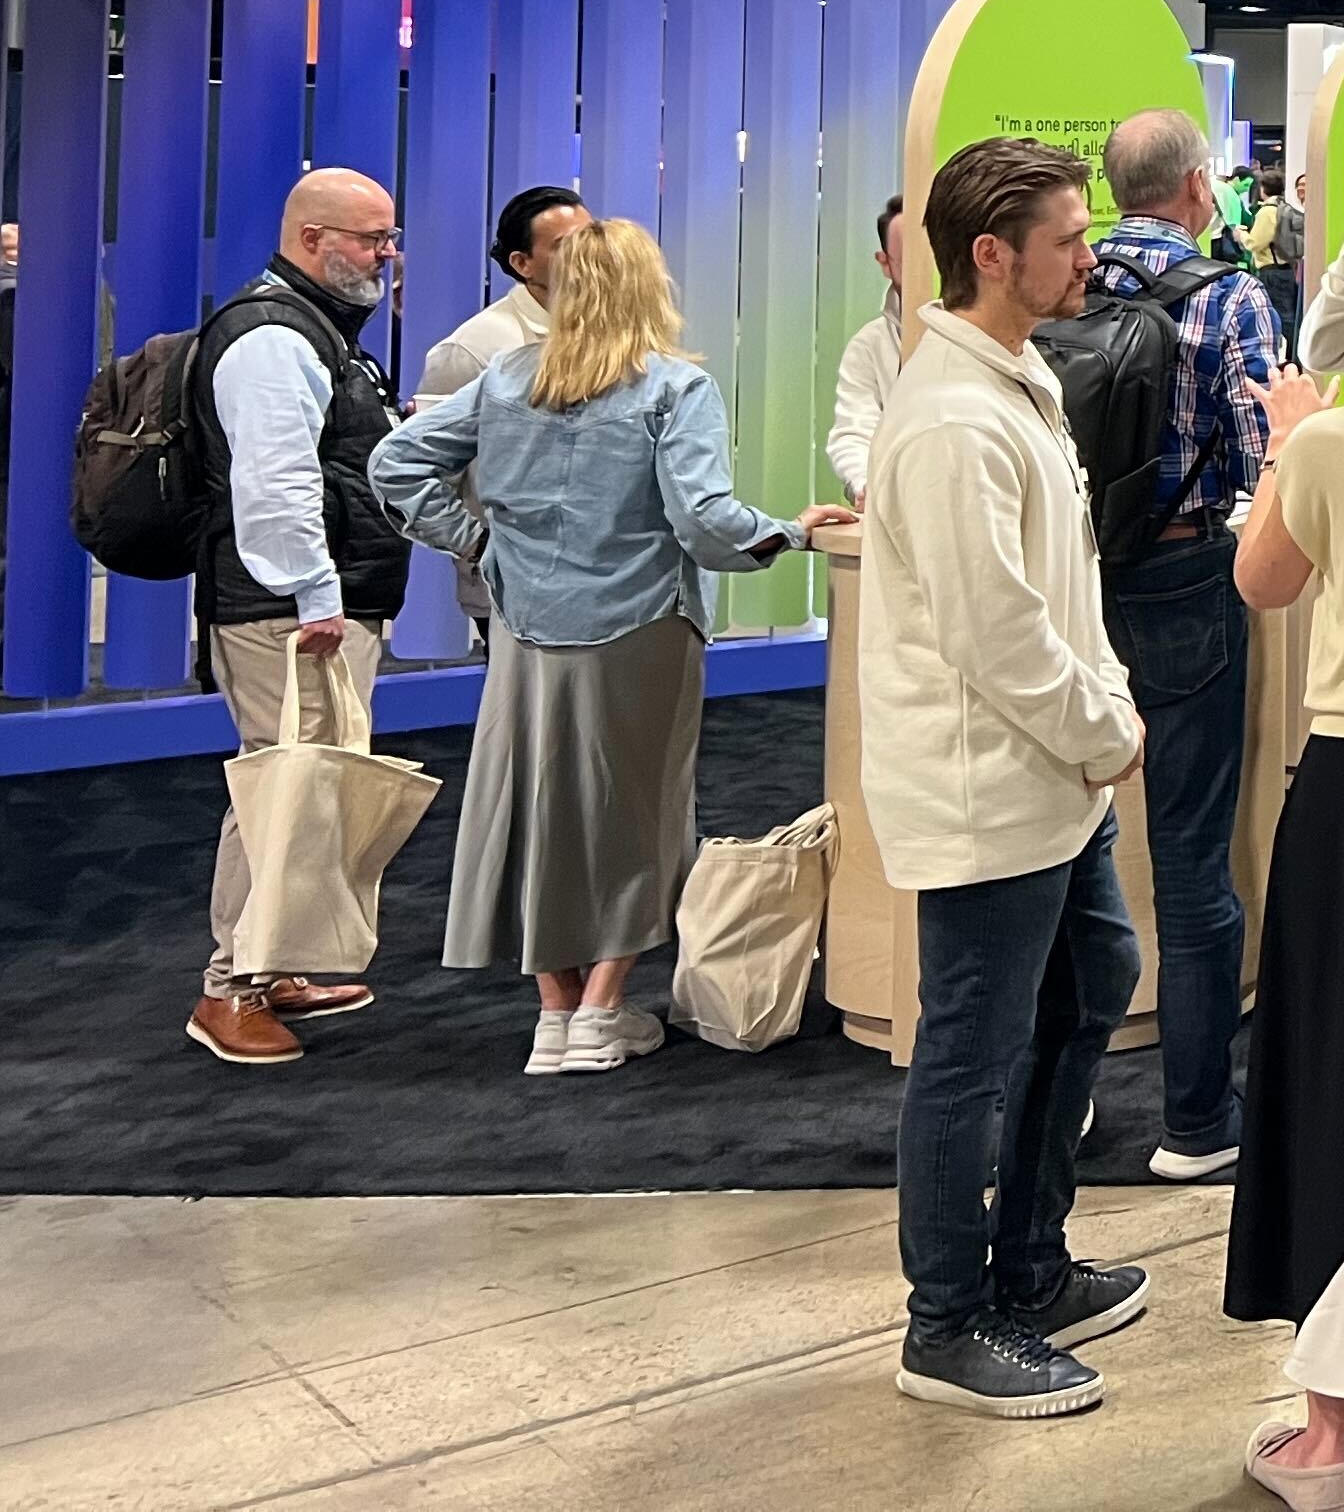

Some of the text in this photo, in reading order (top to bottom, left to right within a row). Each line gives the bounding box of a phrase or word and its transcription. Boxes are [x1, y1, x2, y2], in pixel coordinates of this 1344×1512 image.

[1024, 120, 1033, 132] a
[1036, 119, 1060, 132] one
[1064, 119, 1107, 135] person
